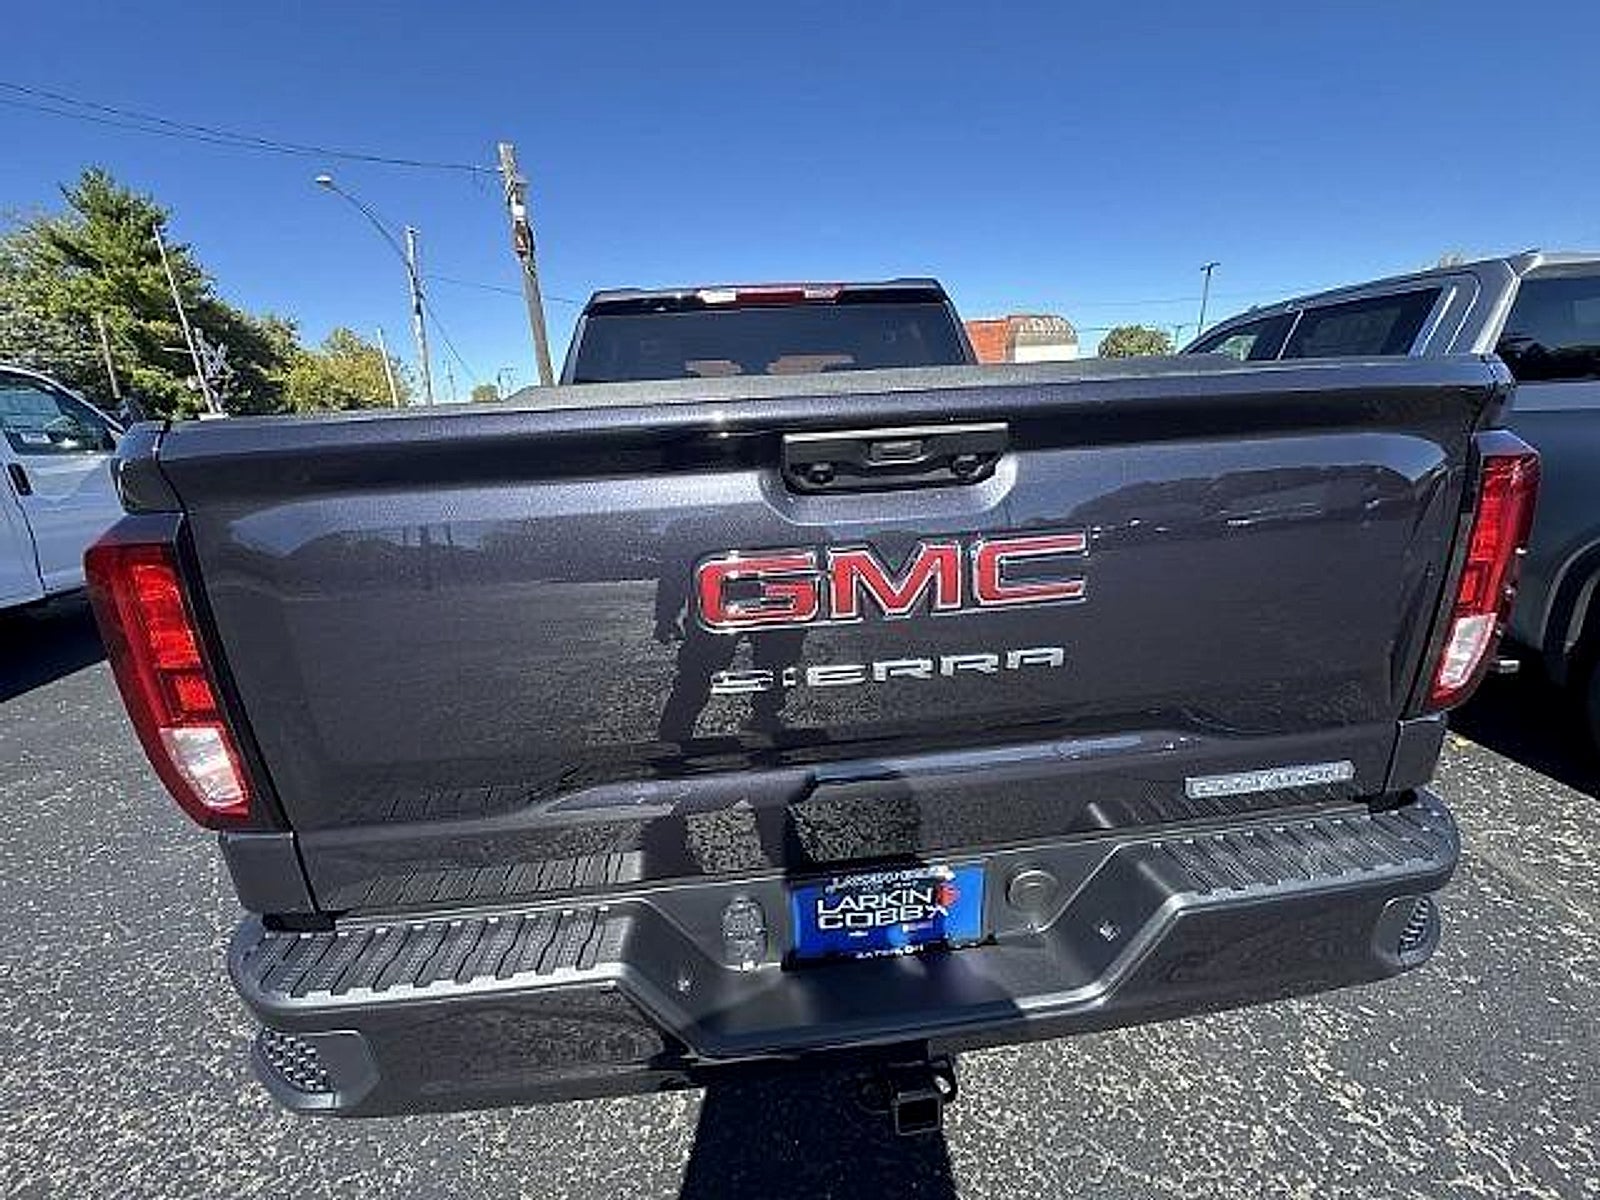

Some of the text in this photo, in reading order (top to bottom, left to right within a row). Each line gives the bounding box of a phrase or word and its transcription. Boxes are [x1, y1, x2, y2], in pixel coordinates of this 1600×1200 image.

[697, 531, 1087, 634] GMC
[711, 646, 1065, 694] SIERRA
[817, 887, 933, 914] LARKIN
